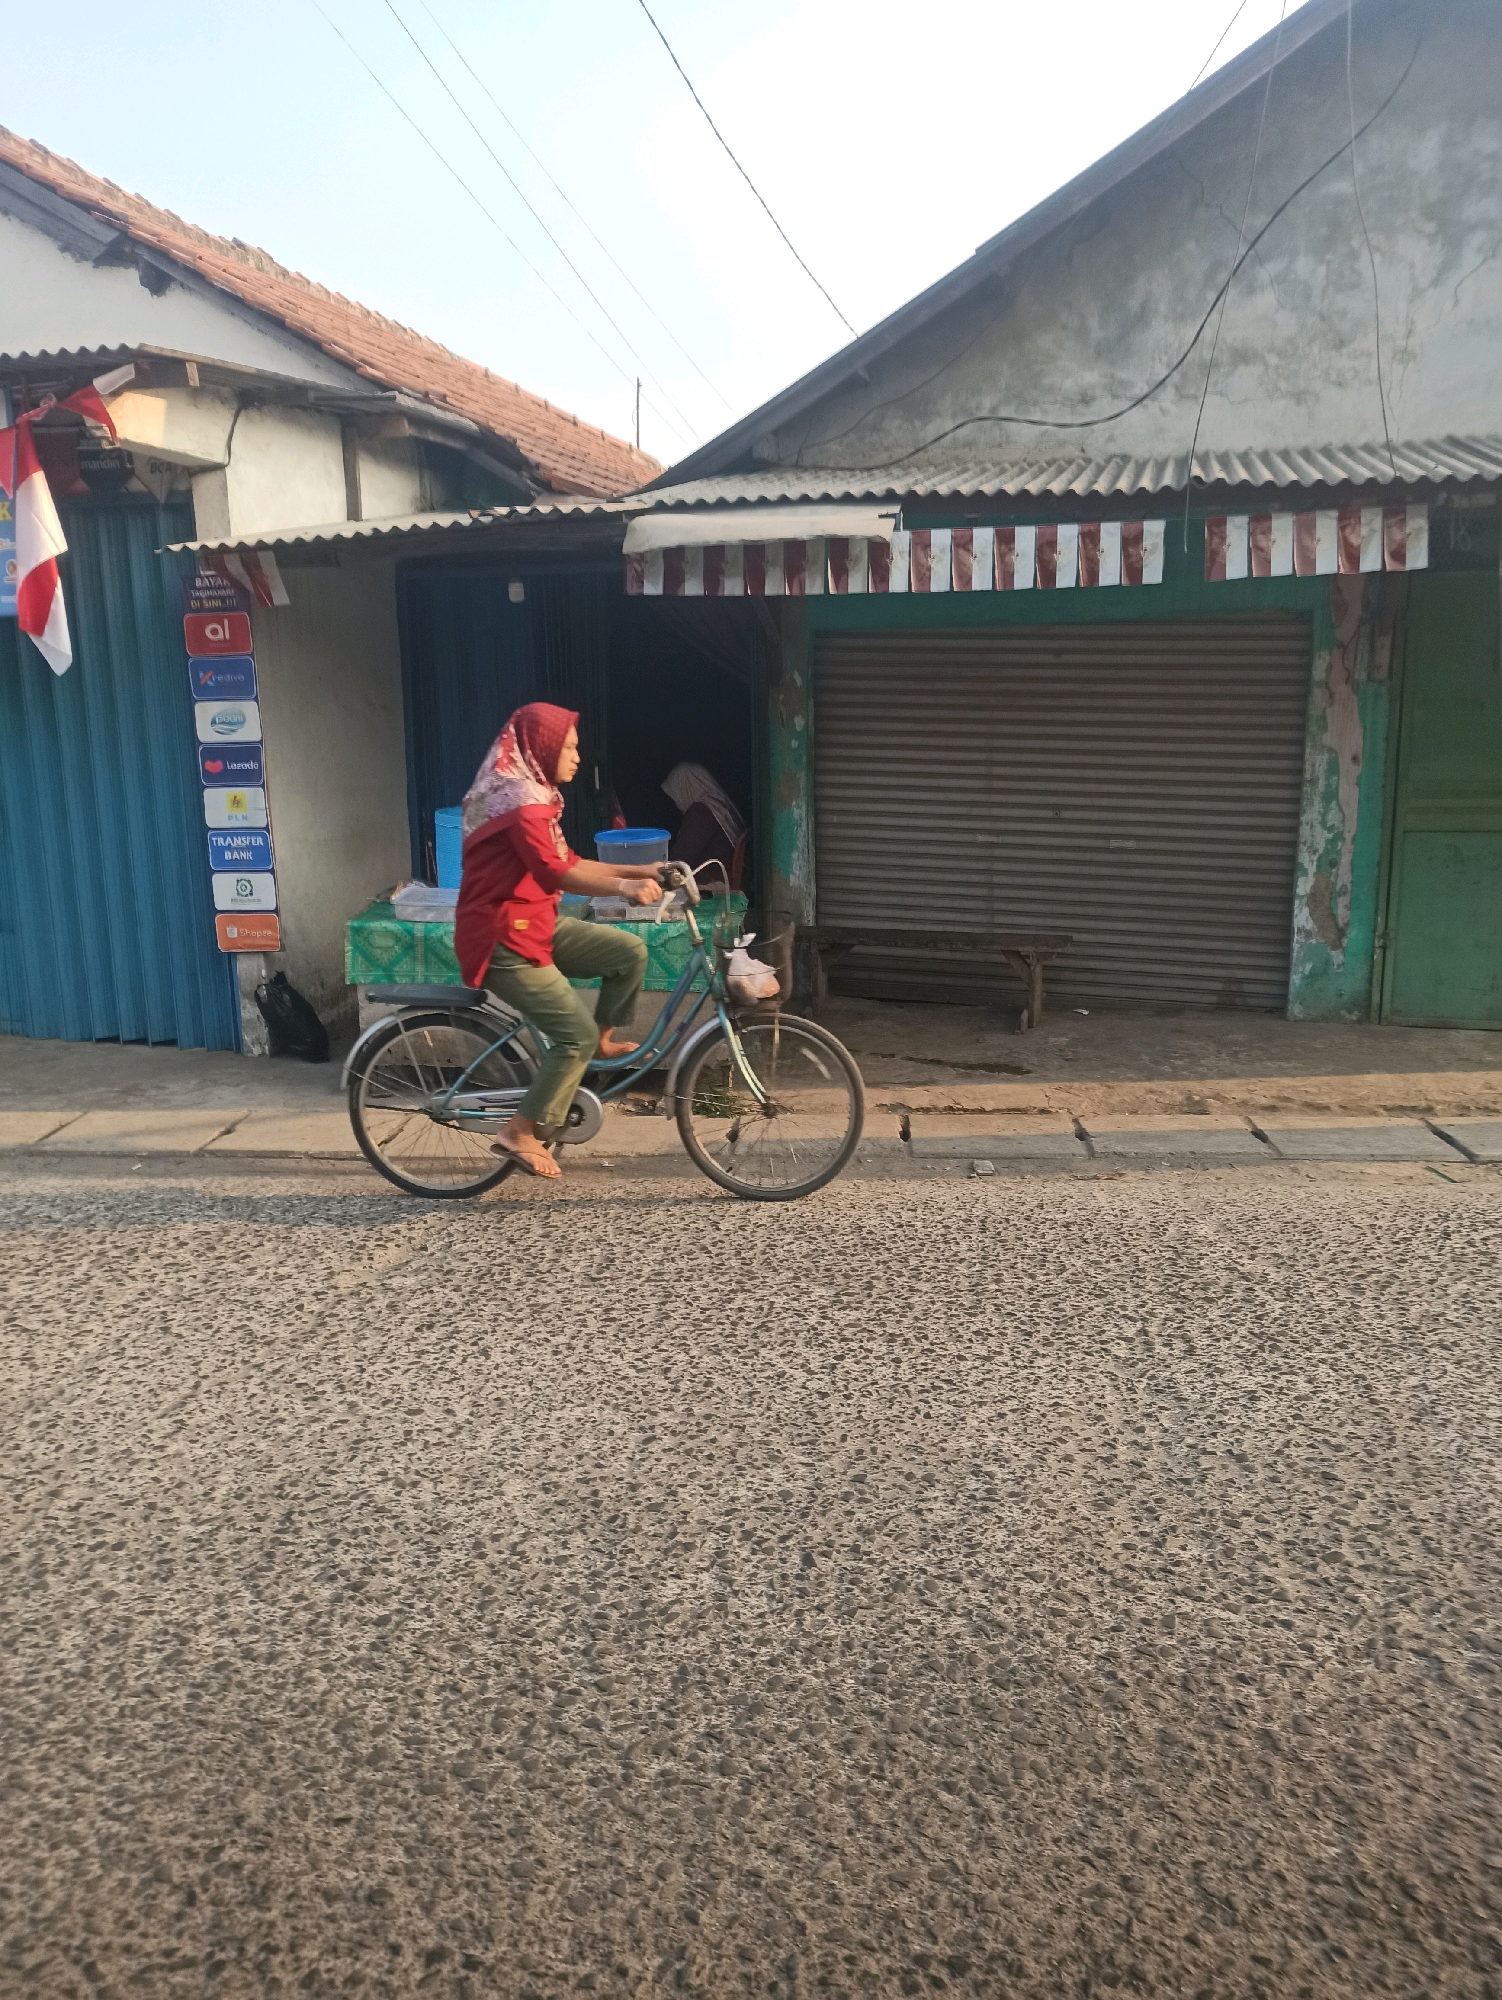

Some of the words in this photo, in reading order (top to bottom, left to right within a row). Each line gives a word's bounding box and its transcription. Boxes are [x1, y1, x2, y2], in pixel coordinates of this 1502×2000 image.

[199, 670, 245, 687] Kredivo
[211, 836, 264, 847] TRANSFER
[224, 850, 253, 861] BANK
[240, 928, 272, 938] Shopee
